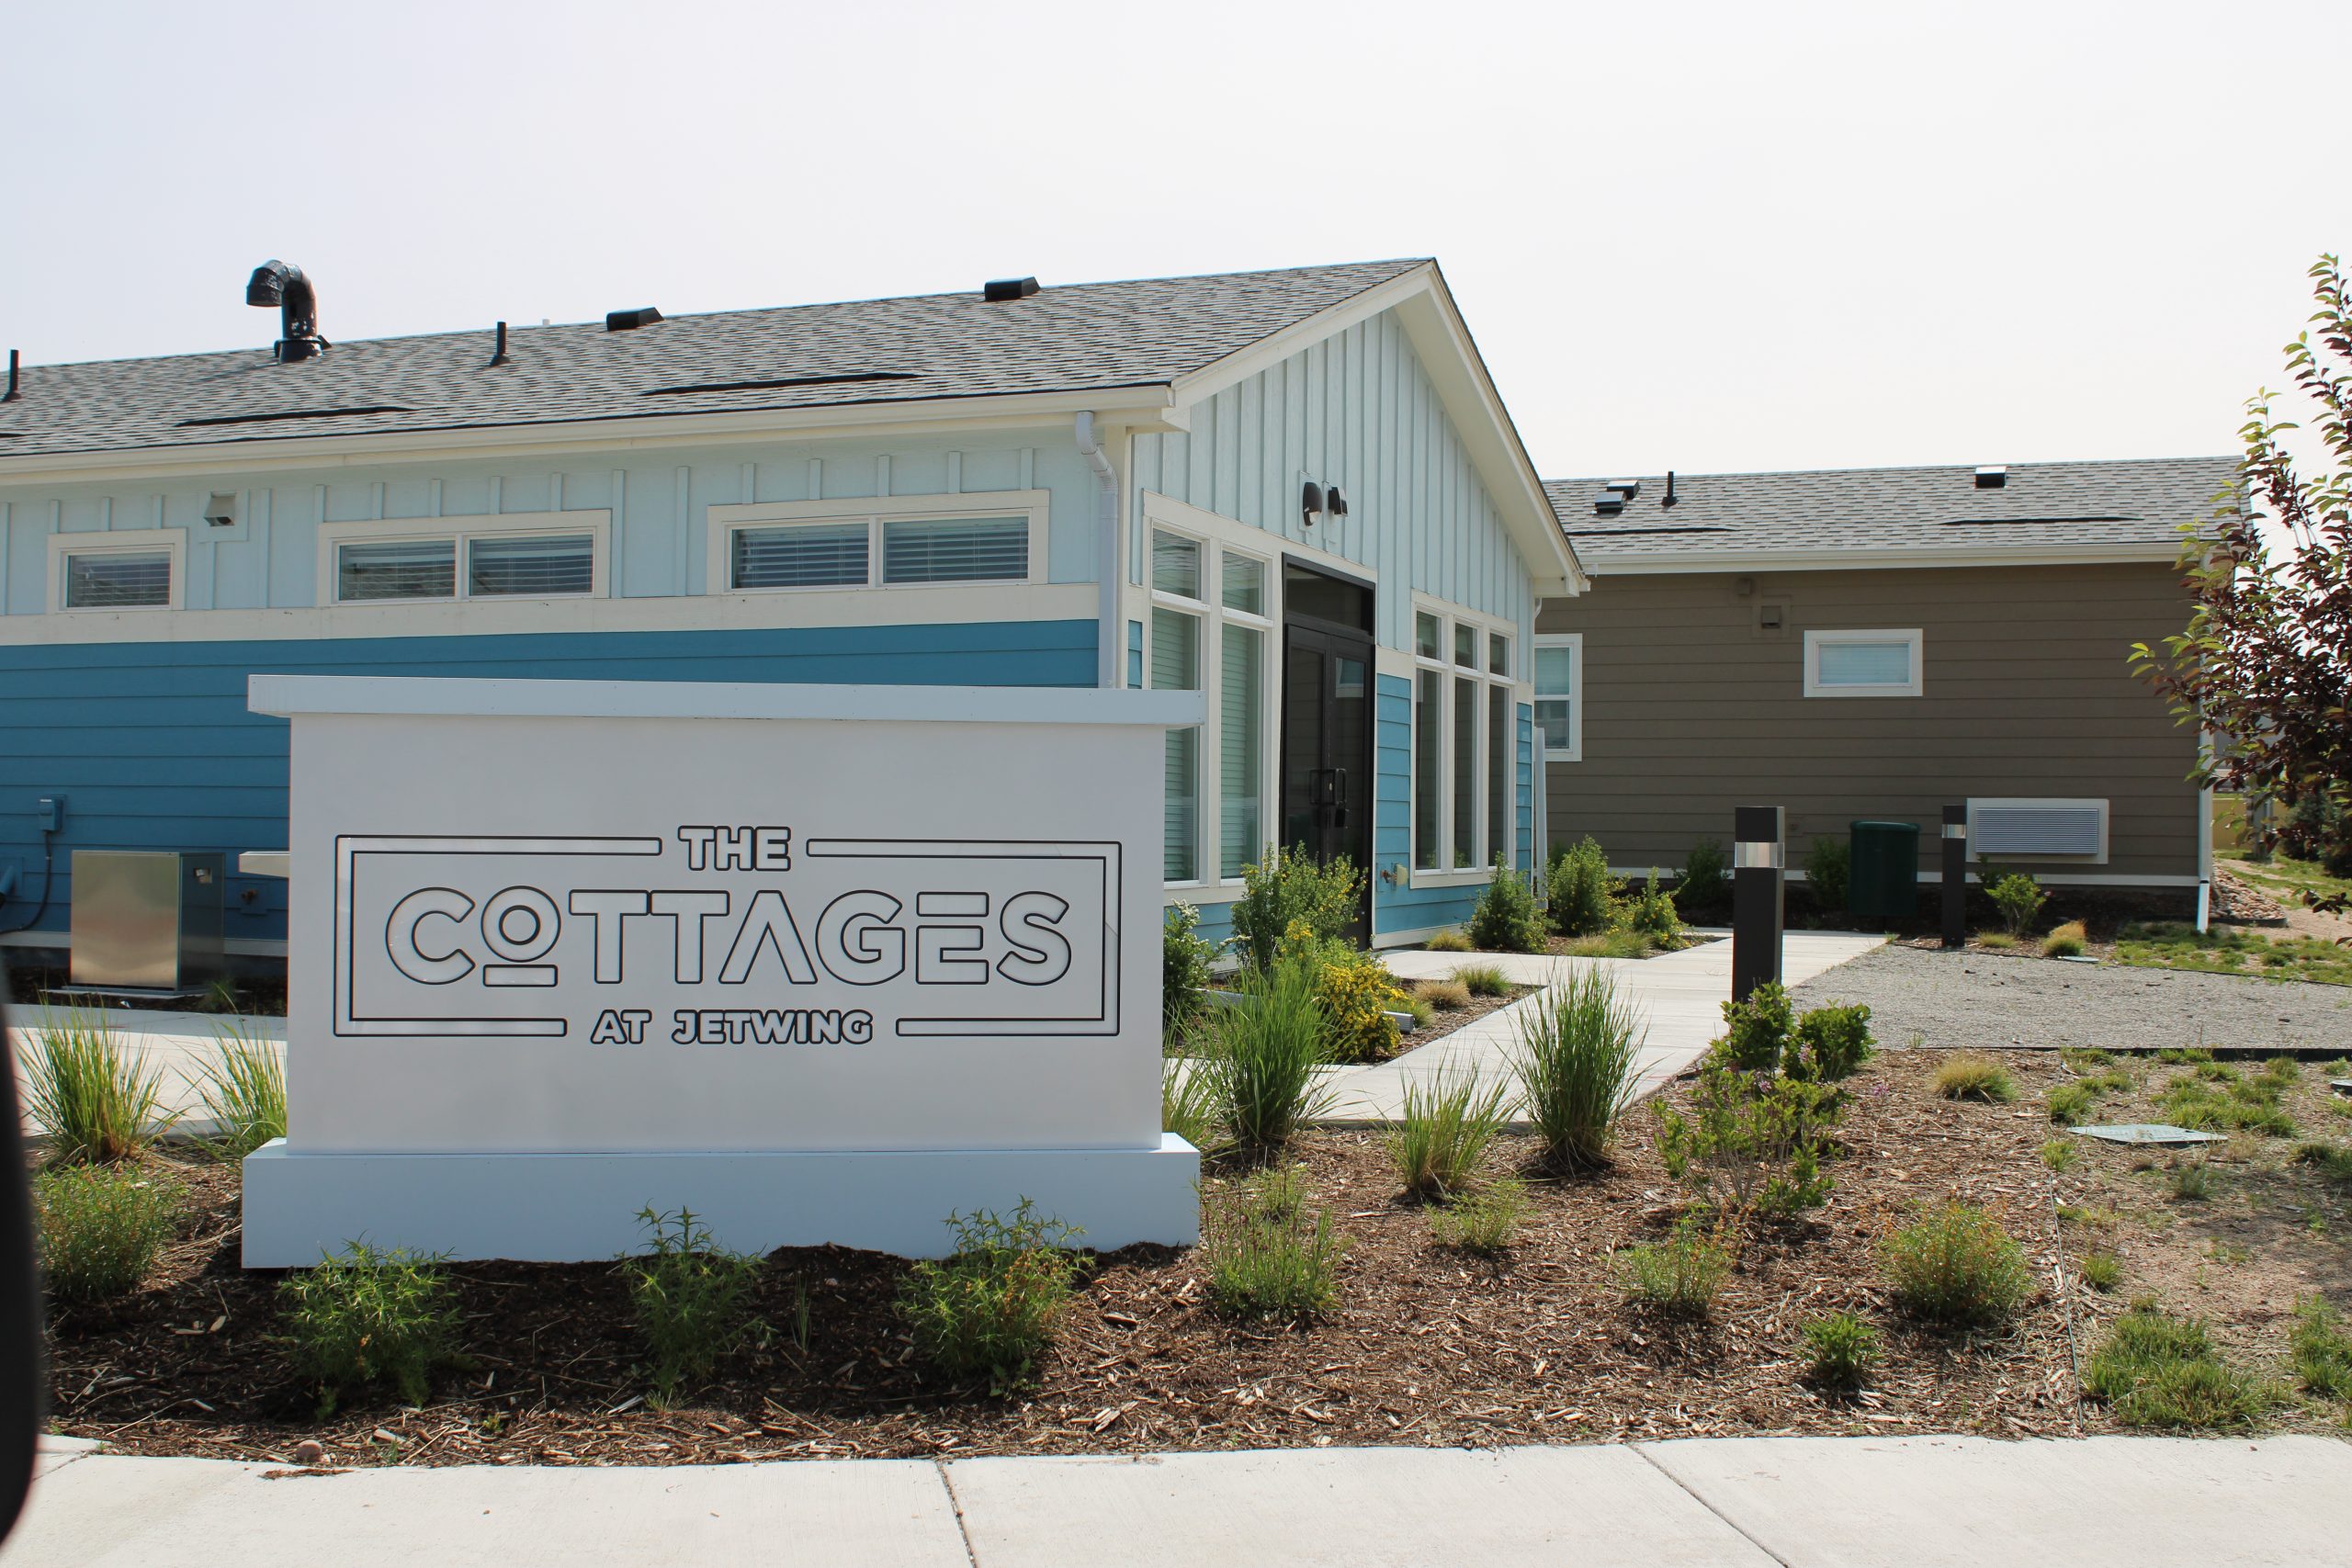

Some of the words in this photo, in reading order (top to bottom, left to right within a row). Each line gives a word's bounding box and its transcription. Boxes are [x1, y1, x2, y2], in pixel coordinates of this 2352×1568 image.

[678, 826, 791, 872] THE
[386, 885, 1072, 987] COTTAGES
[590, 1010, 652, 1044] AT
[672, 1010, 873, 1044] JETWING
